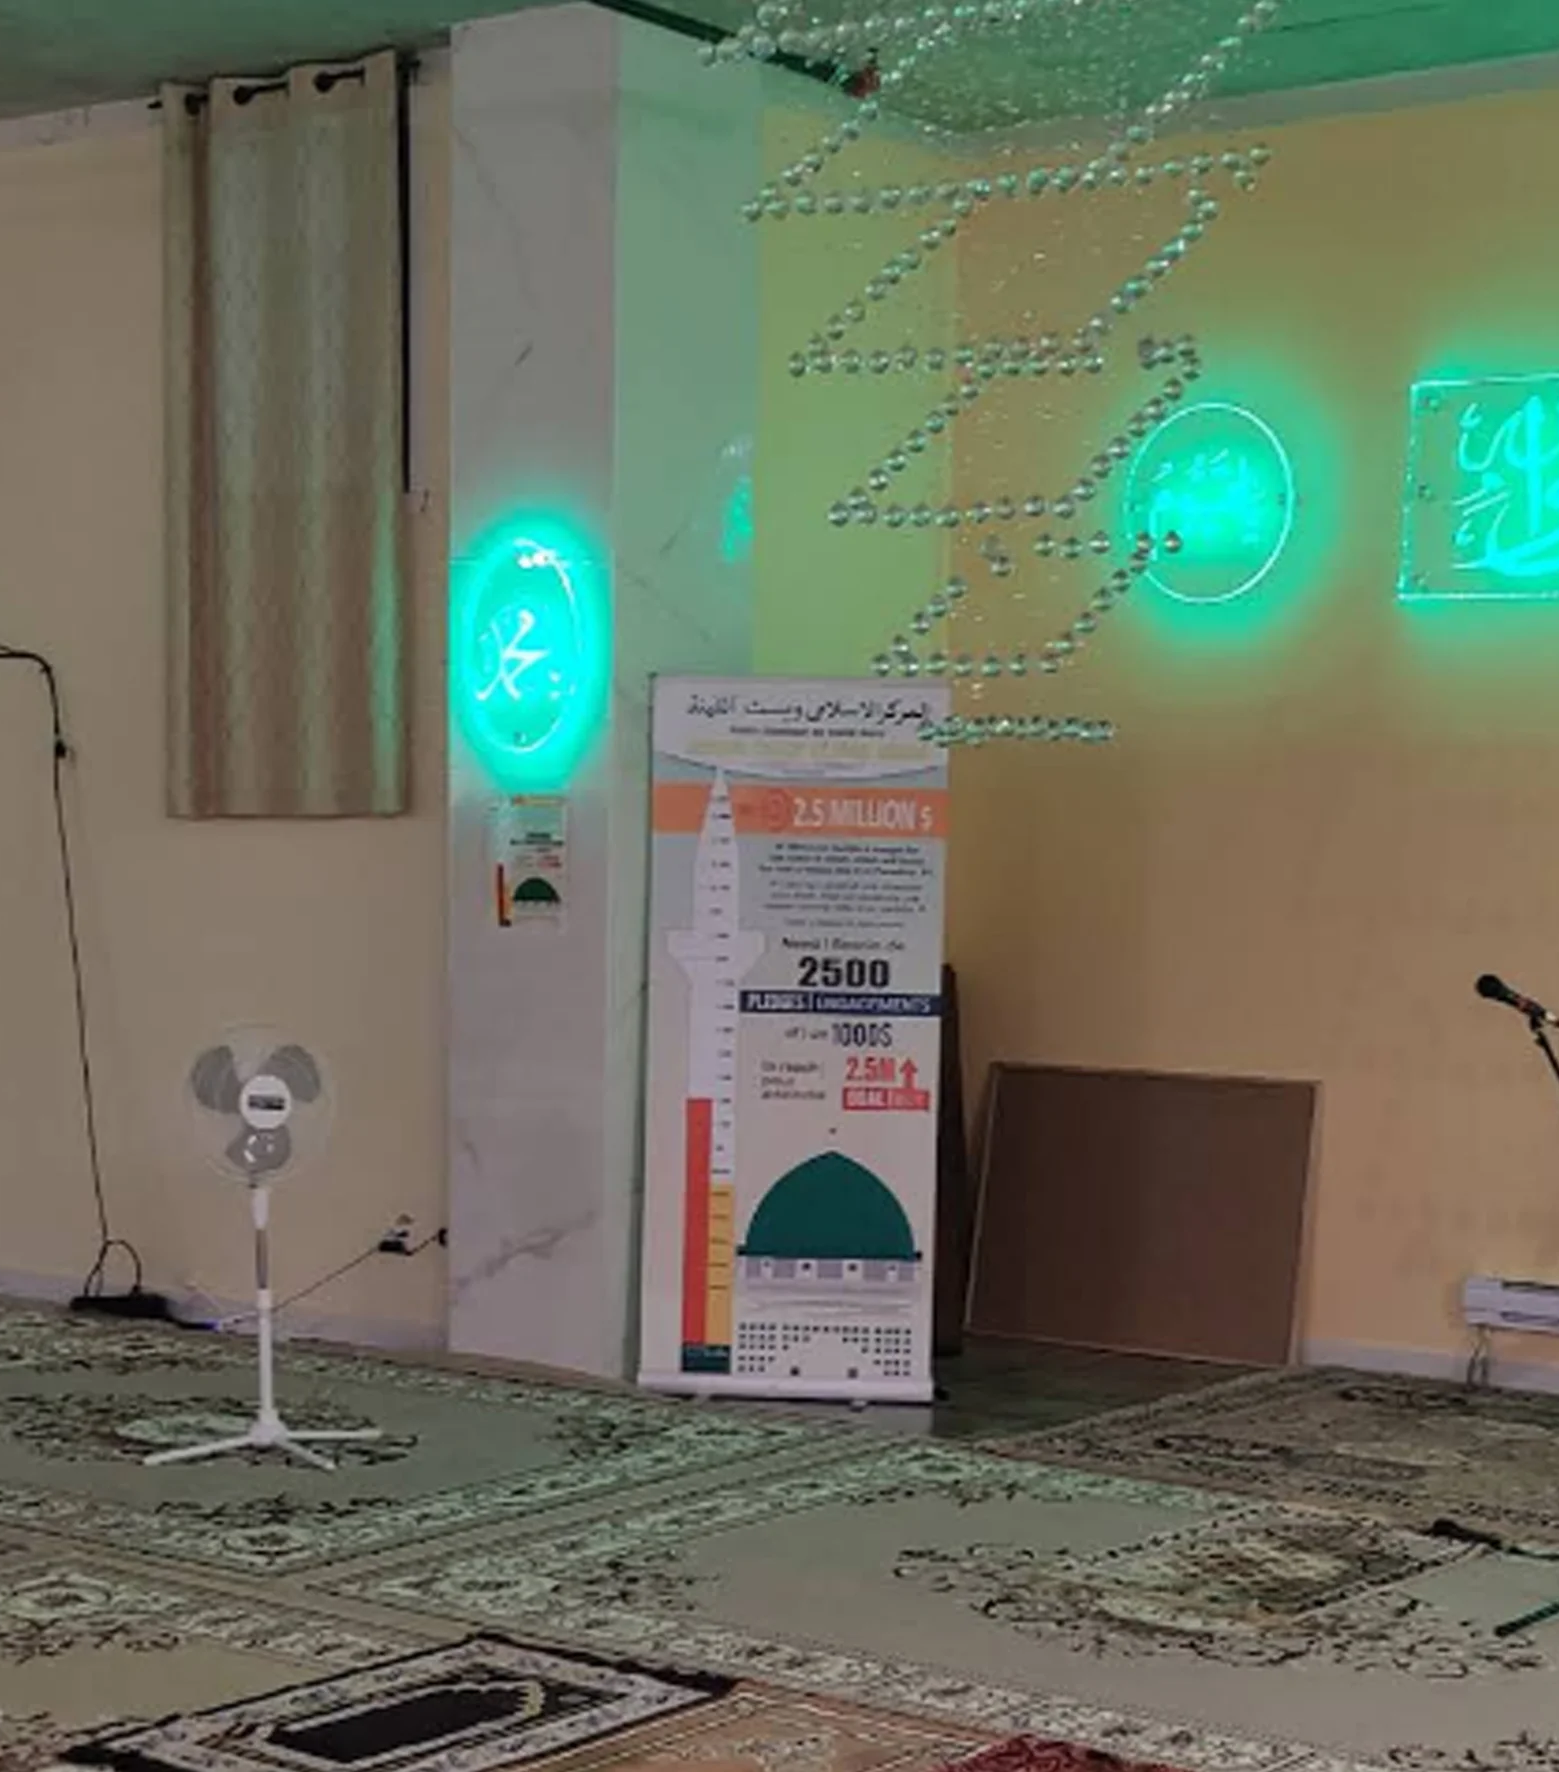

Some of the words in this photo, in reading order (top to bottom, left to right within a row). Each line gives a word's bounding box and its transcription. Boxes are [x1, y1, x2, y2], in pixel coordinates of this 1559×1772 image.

[793, 798, 825, 828] 2.5
[828, 799, 917, 830] MILLION
[798, 956, 890, 988] 2500
[747, 993, 806, 1011] PLEDGES
[846, 1056, 896, 1082] 2.5M
